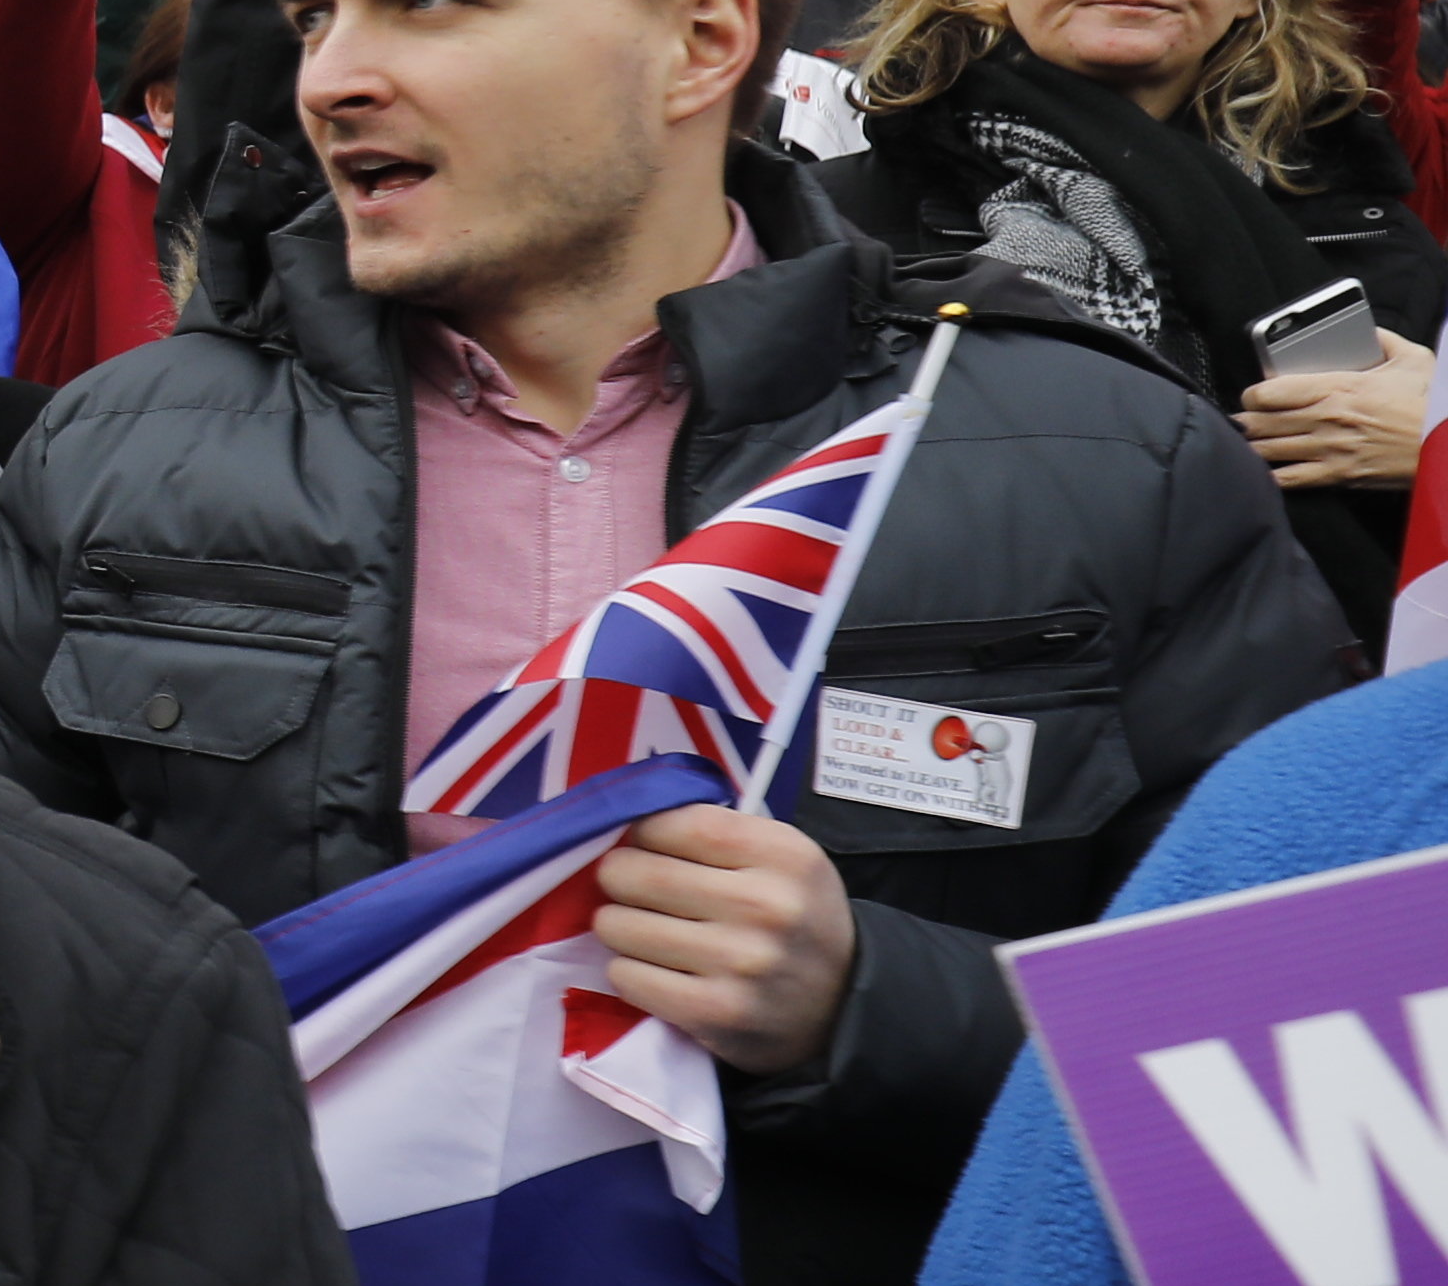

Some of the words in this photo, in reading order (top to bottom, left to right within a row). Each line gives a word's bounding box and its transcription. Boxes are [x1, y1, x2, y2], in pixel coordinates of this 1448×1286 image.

[826, 695, 889, 718] SHOUT
[833, 718, 885, 738] LOUD
[890, 727, 904, 741] &
[822, 774, 859, 790] NOW
[866, 782, 899, 796] GET
[904, 789, 926, 802] ON
